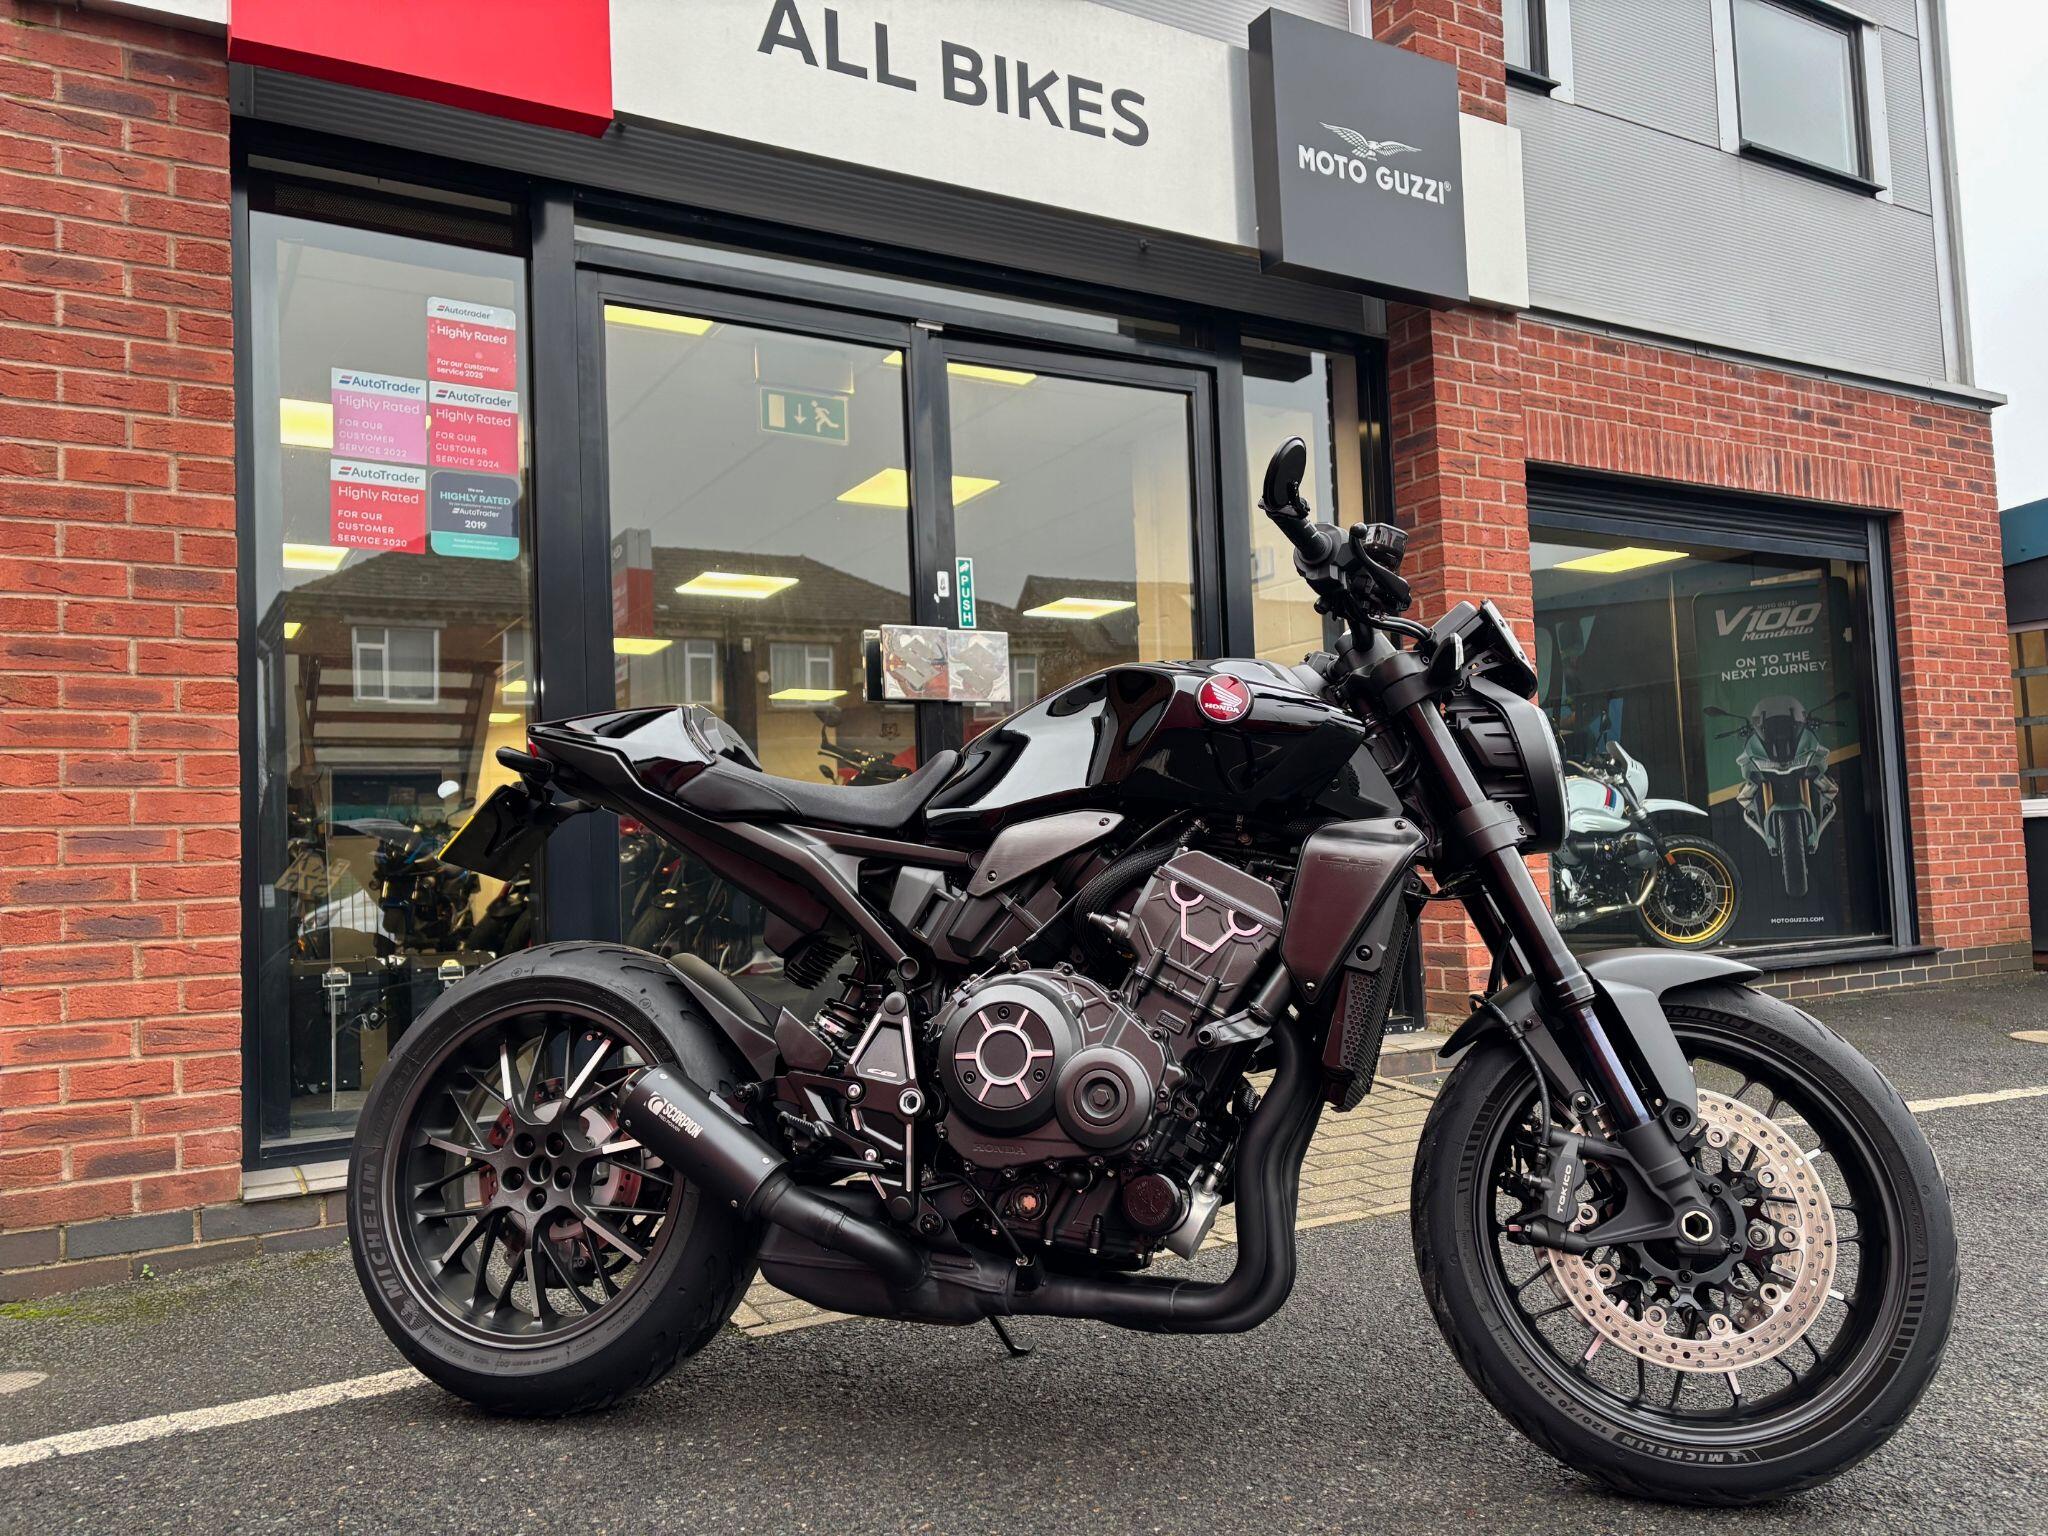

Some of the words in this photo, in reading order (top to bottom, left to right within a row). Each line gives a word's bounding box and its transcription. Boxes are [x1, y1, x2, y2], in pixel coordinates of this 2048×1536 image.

[757, 0, 917, 92] ALL
[941, 40, 1149, 147] BIKES
[1298, 144, 1368, 184] MOTO
[444, 306, 491, 320] Autotrader
[437, 325, 473, 341] Highly
[474, 331, 507, 345] Rated
[437, 358, 449, 366] For
[450, 360, 463, 368] our
[464, 362, 500, 373] customer
[437, 367, 465, 377] service
[465, 370, 484, 380] 2025
[352, 376, 420, 394] AutoTrader
[339, 394, 380, 411] Highly
[382, 400, 420, 415] Rated
[447, 391, 512, 407] AutoTrader
[339, 418, 359, 428] FOR
[361, 420, 383, 430] OUR
[436, 408, 475, 425] Highly
[476, 413, 512, 428] Rated
[338, 430, 395, 444] CUSTOMER
[435, 431, 454, 440] FOR
[456, 433, 477, 443] OUR
[339, 442, 382, 455] SERVICE
[383, 447, 408, 458] 2022
[435, 442, 488, 456] CUSTOMER
[435, 454, 475, 466] SERVICE
[477, 459, 500, 469] 2024
[351, 467, 420, 485] AutoTrader
[338, 485, 380, 501] Highly
[381, 490, 419, 505] Rated
[440, 491, 478, 503] HIGHLY
[479, 495, 511, 506] RATED
[337, 509, 358, 519] FOR
[361, 511, 382, 521] OUR
[459, 508, 500, 518] AutoTrader
[337, 521, 395, 535] CUSTOMER
[465, 520, 487, 530] 2019
[337, 533, 380, 546] SERVICE
[383, 538, 408, 548] 2020
[960, 575, 972, 623] PUSH
[1715, 602, 1822, 637] V100
[1741, 625, 1814, 642] Mandello
[1736, 657, 1756, 668] ON
[1760, 654, 1780, 665] TO
[1783, 650, 1810, 662] THE
[1721, 668, 1757, 682] NEXT
[1762, 660, 1828, 677] JOURNEY
[1204, 702, 1241, 714] HONDA
[662, 1101, 704, 1139] SCORPION
[971, 1142, 1027, 1156] HONDA
[1556, 1164, 1573, 1214] TOKICO
[361, 1163, 404, 1300] MICHELIN
[1519, 1363, 1536, 1380] 17
[1535, 1380, 1556, 1398] ZR
[1619, 1435, 1725, 1463] MICHELIN
